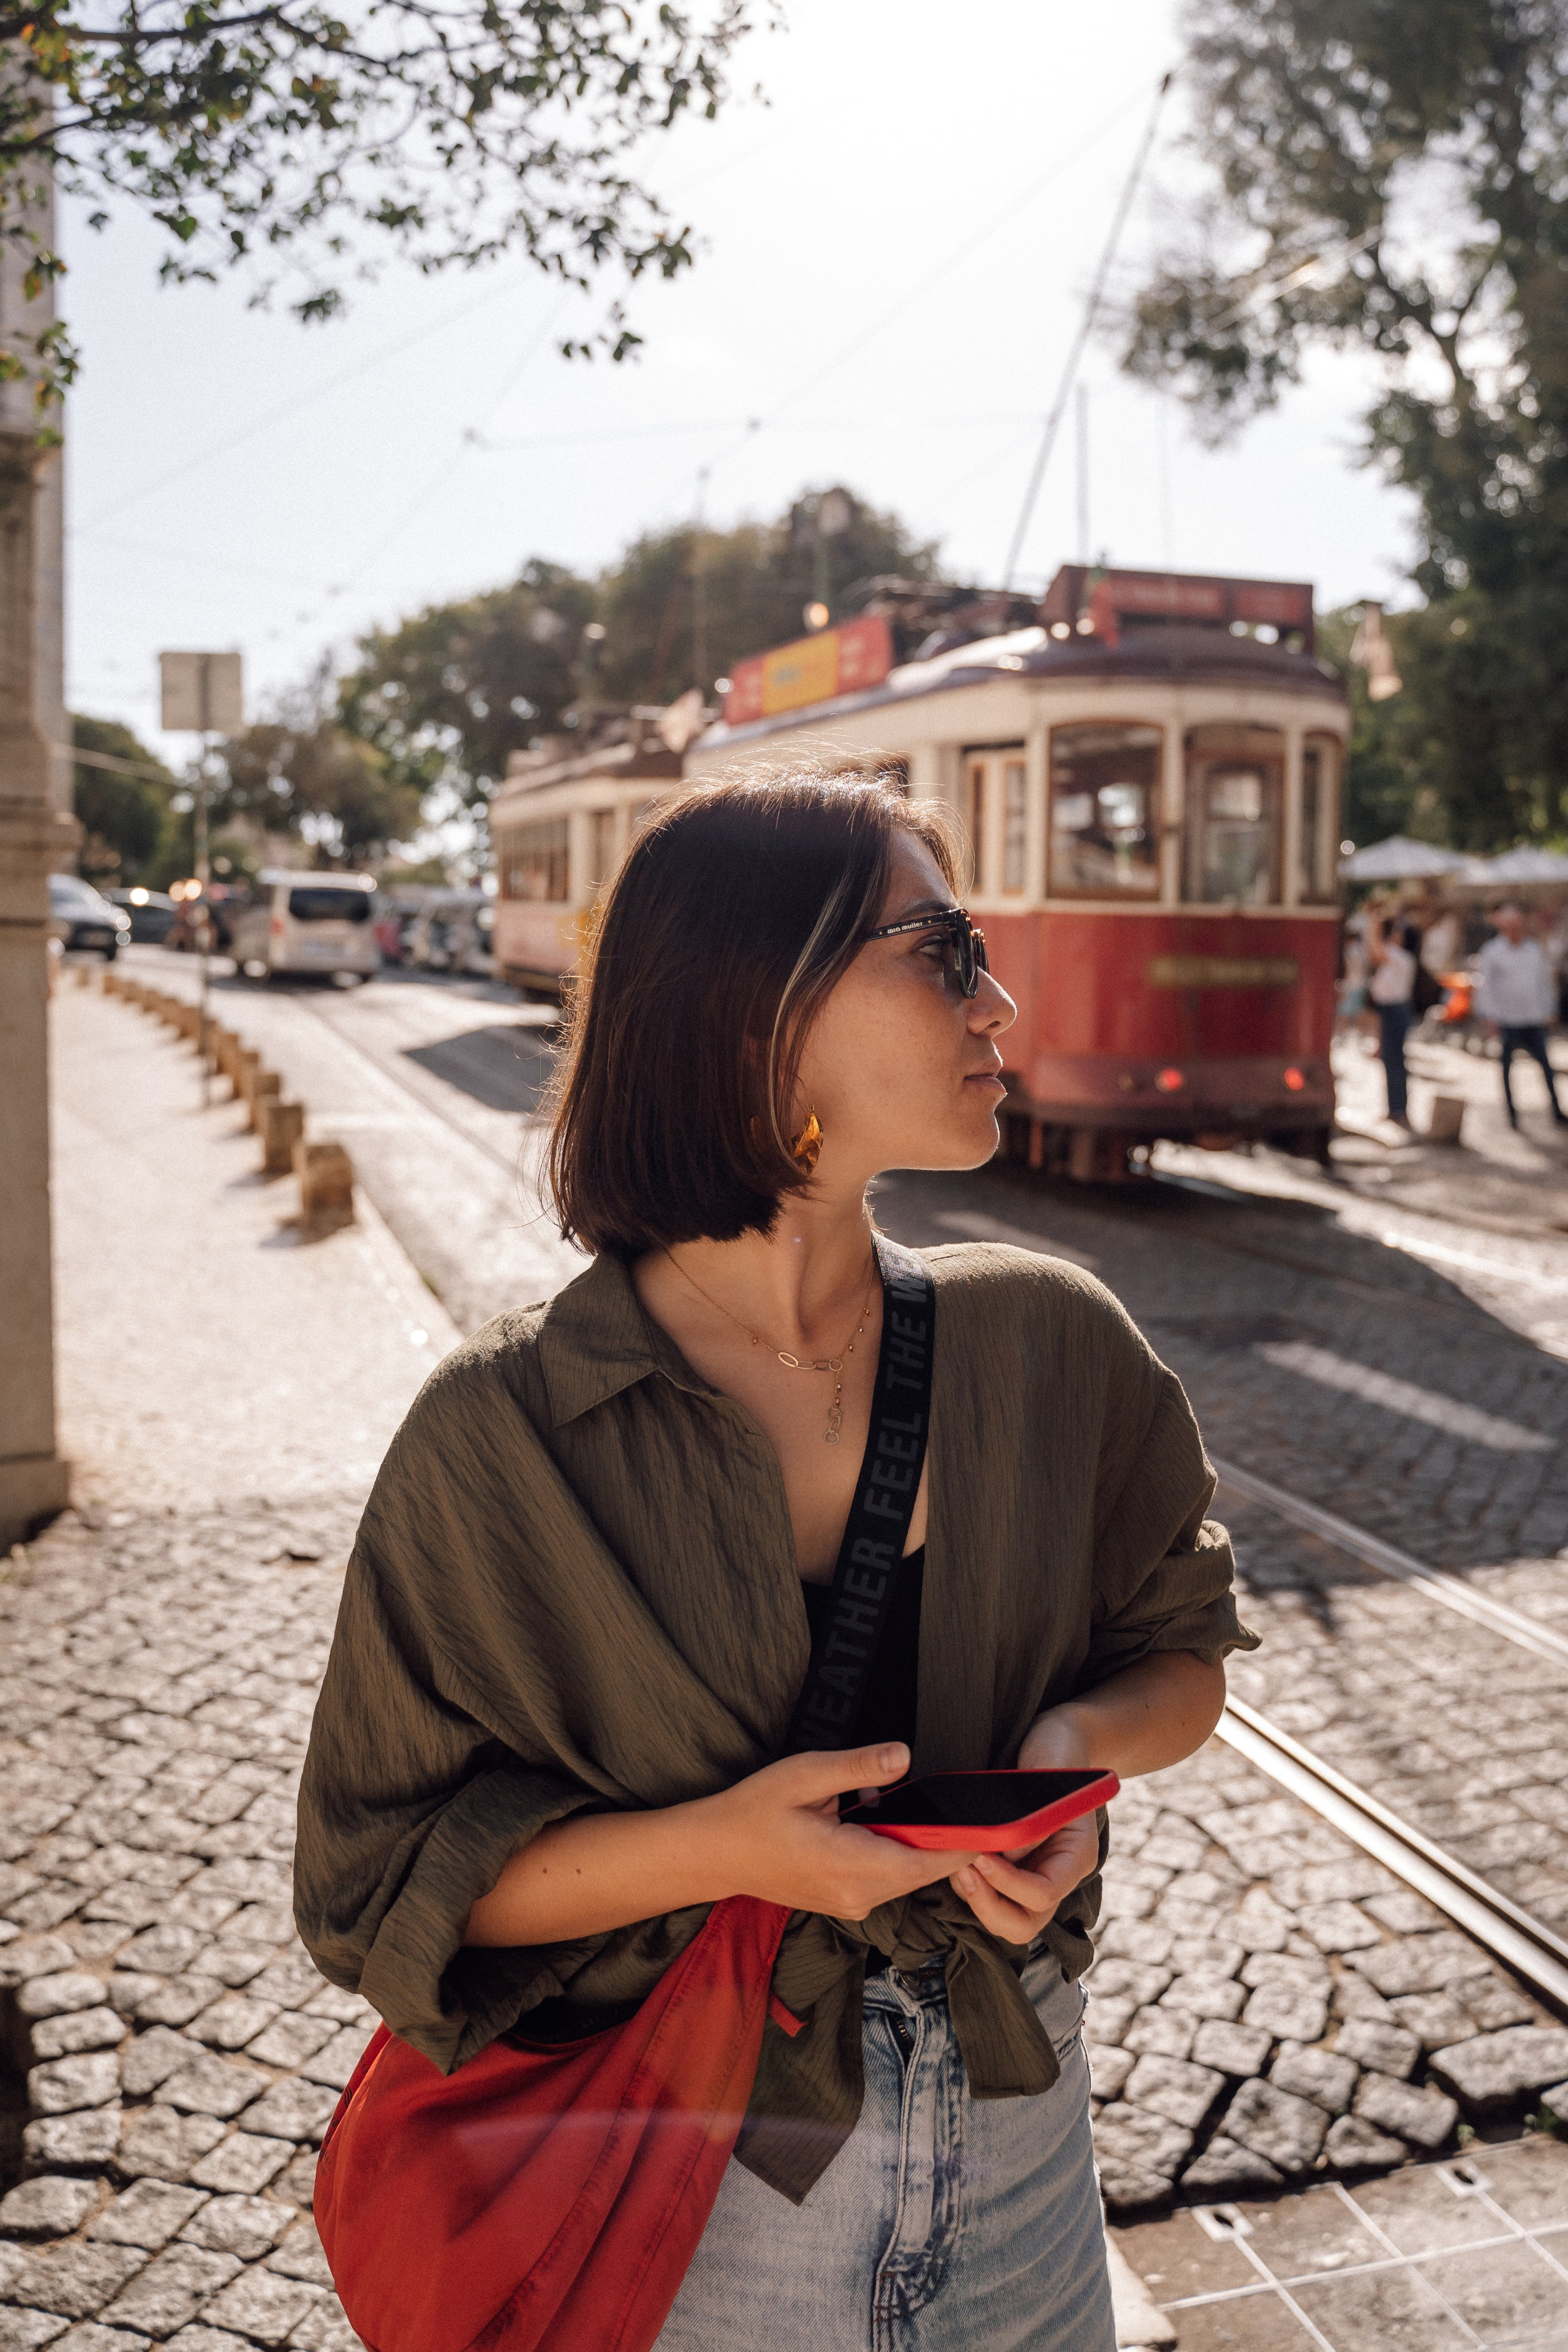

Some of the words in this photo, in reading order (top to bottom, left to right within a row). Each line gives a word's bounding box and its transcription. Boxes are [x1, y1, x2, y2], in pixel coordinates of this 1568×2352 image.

[901, 921, 923, 930] muller
[885, 1310, 927, 1390] THE
[863, 1412, 921, 1521] FEEL
